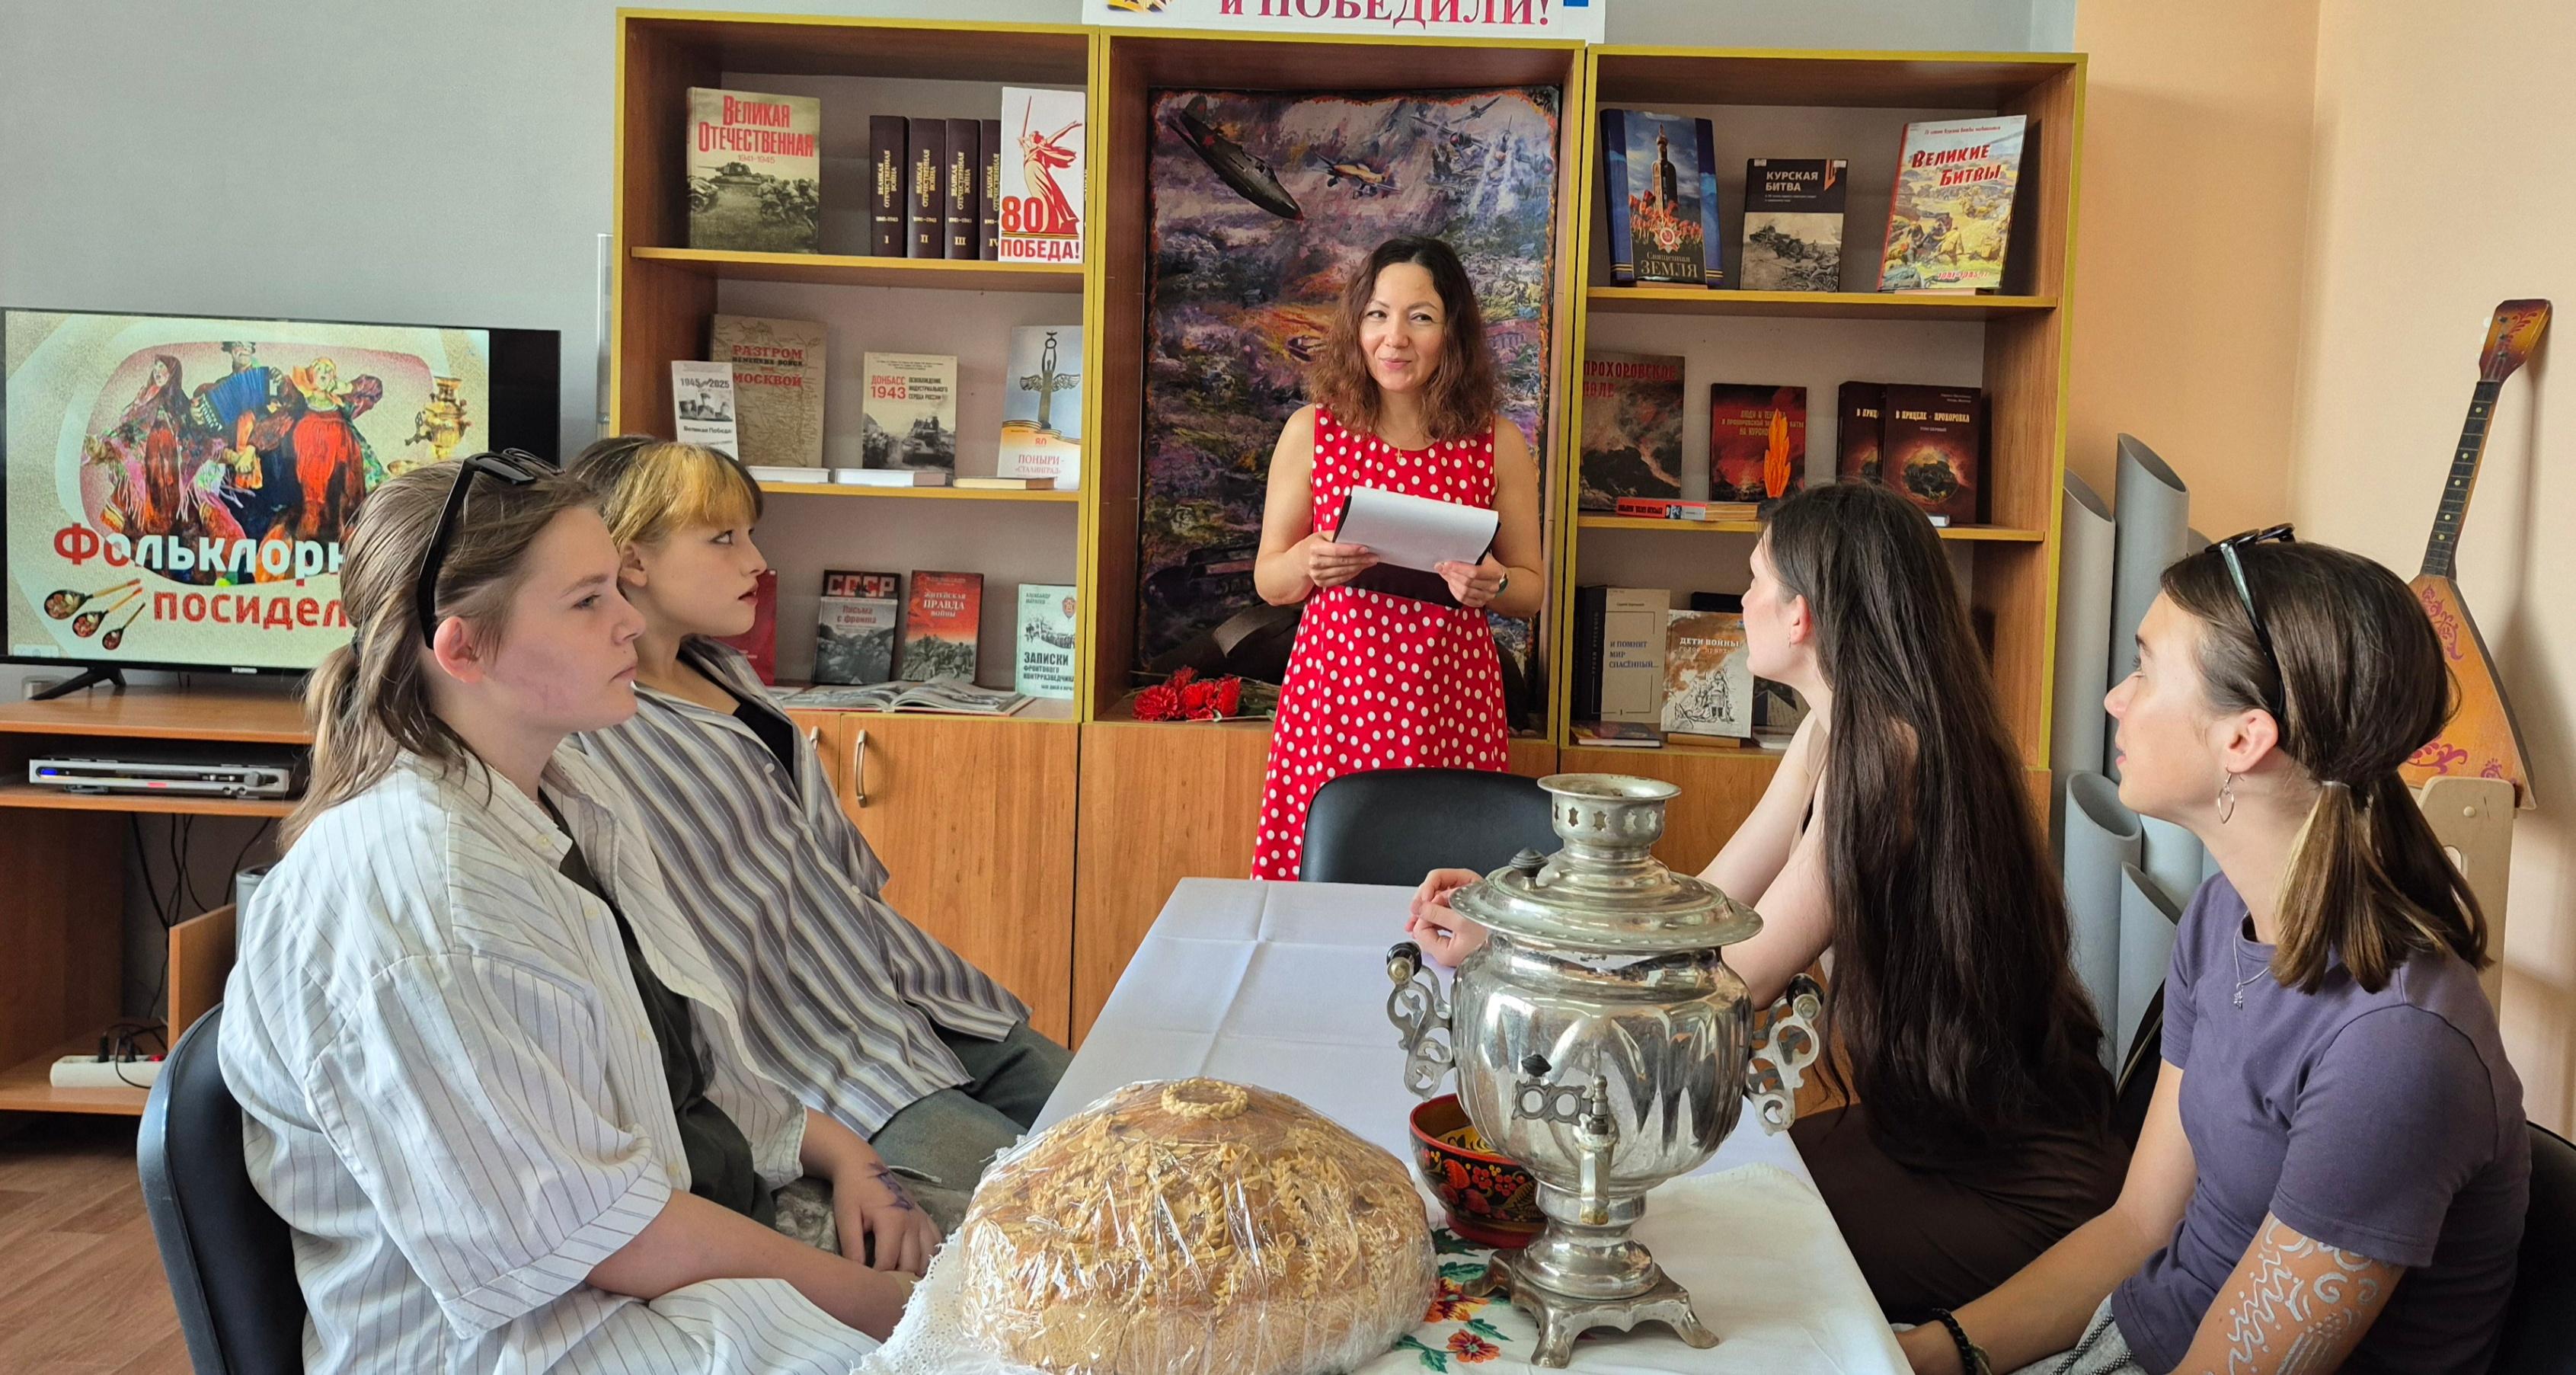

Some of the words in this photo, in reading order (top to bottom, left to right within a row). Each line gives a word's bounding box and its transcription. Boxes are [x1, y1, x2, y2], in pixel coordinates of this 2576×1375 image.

[1258, 0, 1549, 30] ПОБЕДИЛИ!
[723, 94, 791, 128] ВЕЛИКАЯ
[698, 121, 815, 158] ОТЕЧЕСТВЕННАЯ
[1911, 144, 1990, 168] ВЕЛИКИЕ
[1766, 171, 1819, 181] КУРСКАЯ
[1939, 165, 2002, 186] БИТВЫ
[1766, 183, 1801, 192] БИТВА
[1001, 196, 1044, 232] 80
[1000, 239, 1079, 261] ПОБЕДА!
[1641, 259, 1698, 278] ЗЕМЛЯ
[732, 344, 804, 360] РАЗГРОМ
[733, 372, 802, 387] МОСКВОЙ
[871, 375, 906, 385] ДОНБАСС
[871, 385, 906, 399] 1943
[1934, 412, 1970, 423] ПРОХОРОВКА
[1018, 454, 1059, 465] ПОНЫРИ
[826, 575, 895, 598] СССР
[923, 600, 965, 611] ПРАВДА
[1024, 651, 1069, 666] ЗАПИСКИ
